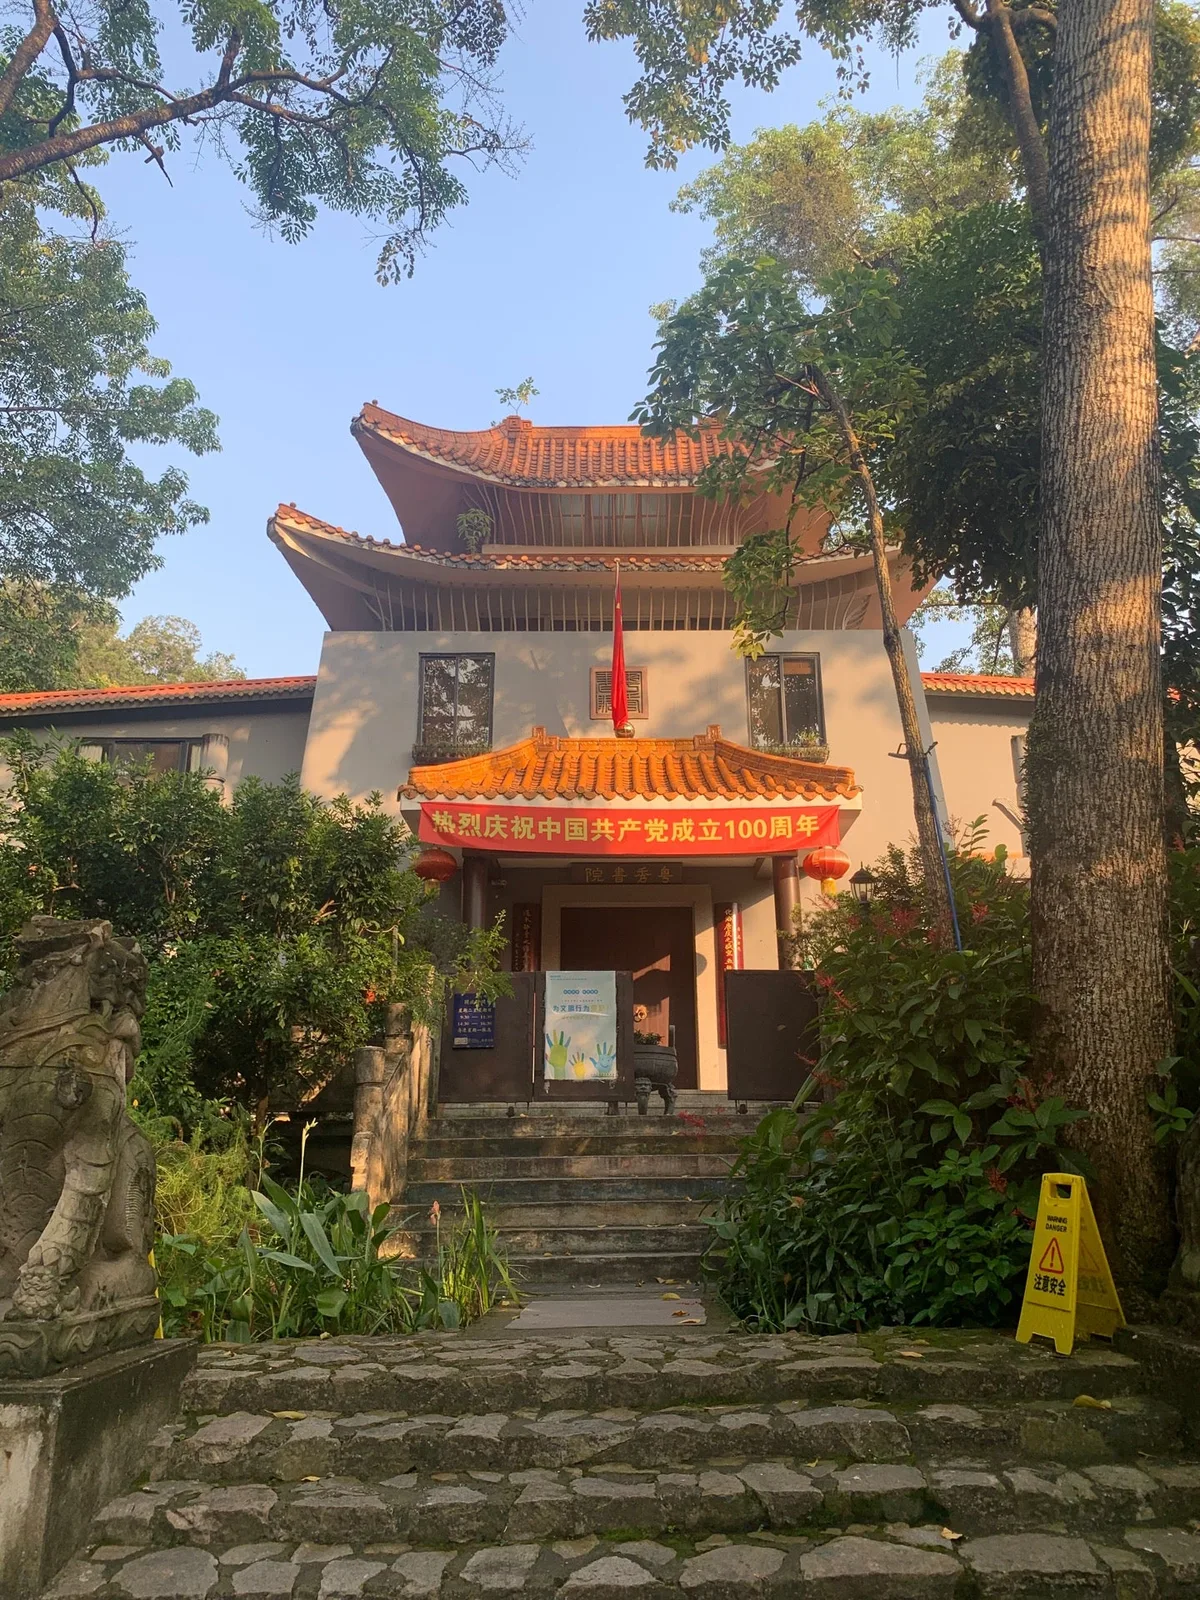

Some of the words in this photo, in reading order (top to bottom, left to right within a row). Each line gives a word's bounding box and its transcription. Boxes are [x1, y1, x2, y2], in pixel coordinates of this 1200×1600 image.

[432, 810, 820, 843] 热烈庆祝中国共产党成立100周年
[1045, 1222, 1068, 1232] DANGER
[1047, 1215, 1068, 1224] WARNING
[1034, 1273, 1067, 1296] 注意安全
